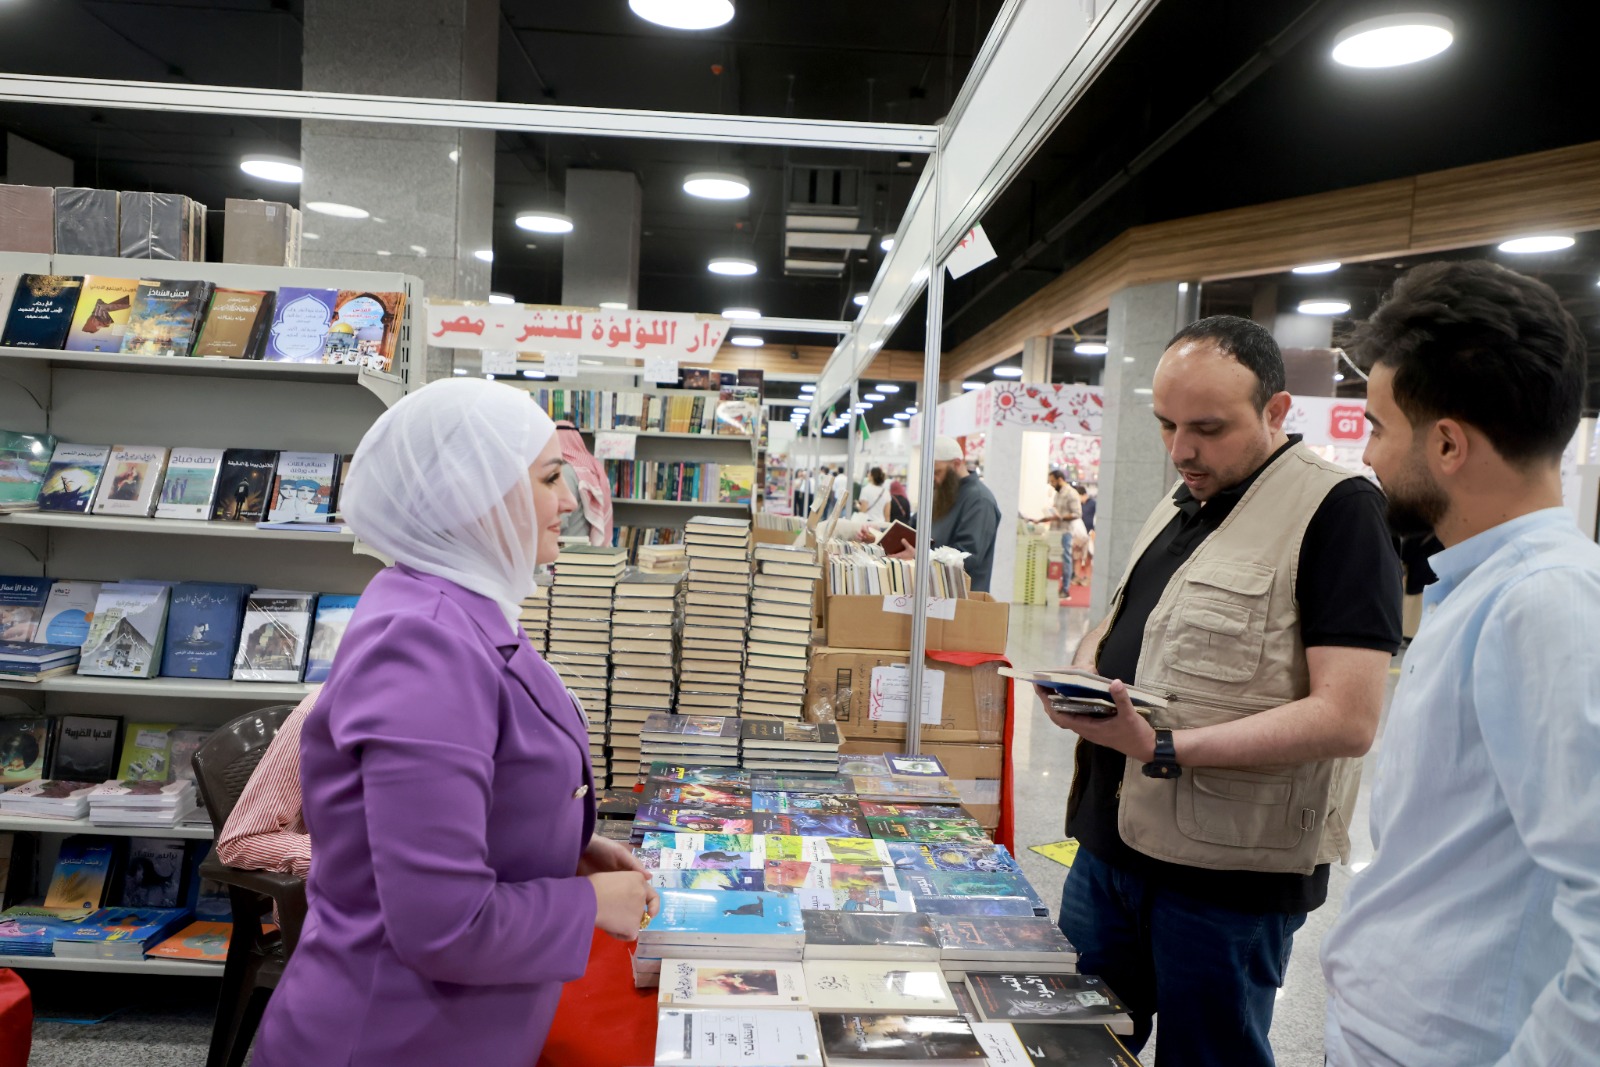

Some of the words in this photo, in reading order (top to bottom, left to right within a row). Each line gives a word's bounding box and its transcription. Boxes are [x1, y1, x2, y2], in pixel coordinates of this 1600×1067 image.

[432, 315, 486, 338] مصر
[516, 312, 583, 344] للنشر
[590, 317, 678, 350] اللؤلؤة
[1338, 418, 1357, 433] G1
[93, 728, 113, 740] الدنيا
[999, 974, 1030, 995] النمر
[1022, 974, 1056, 999] الأسود
